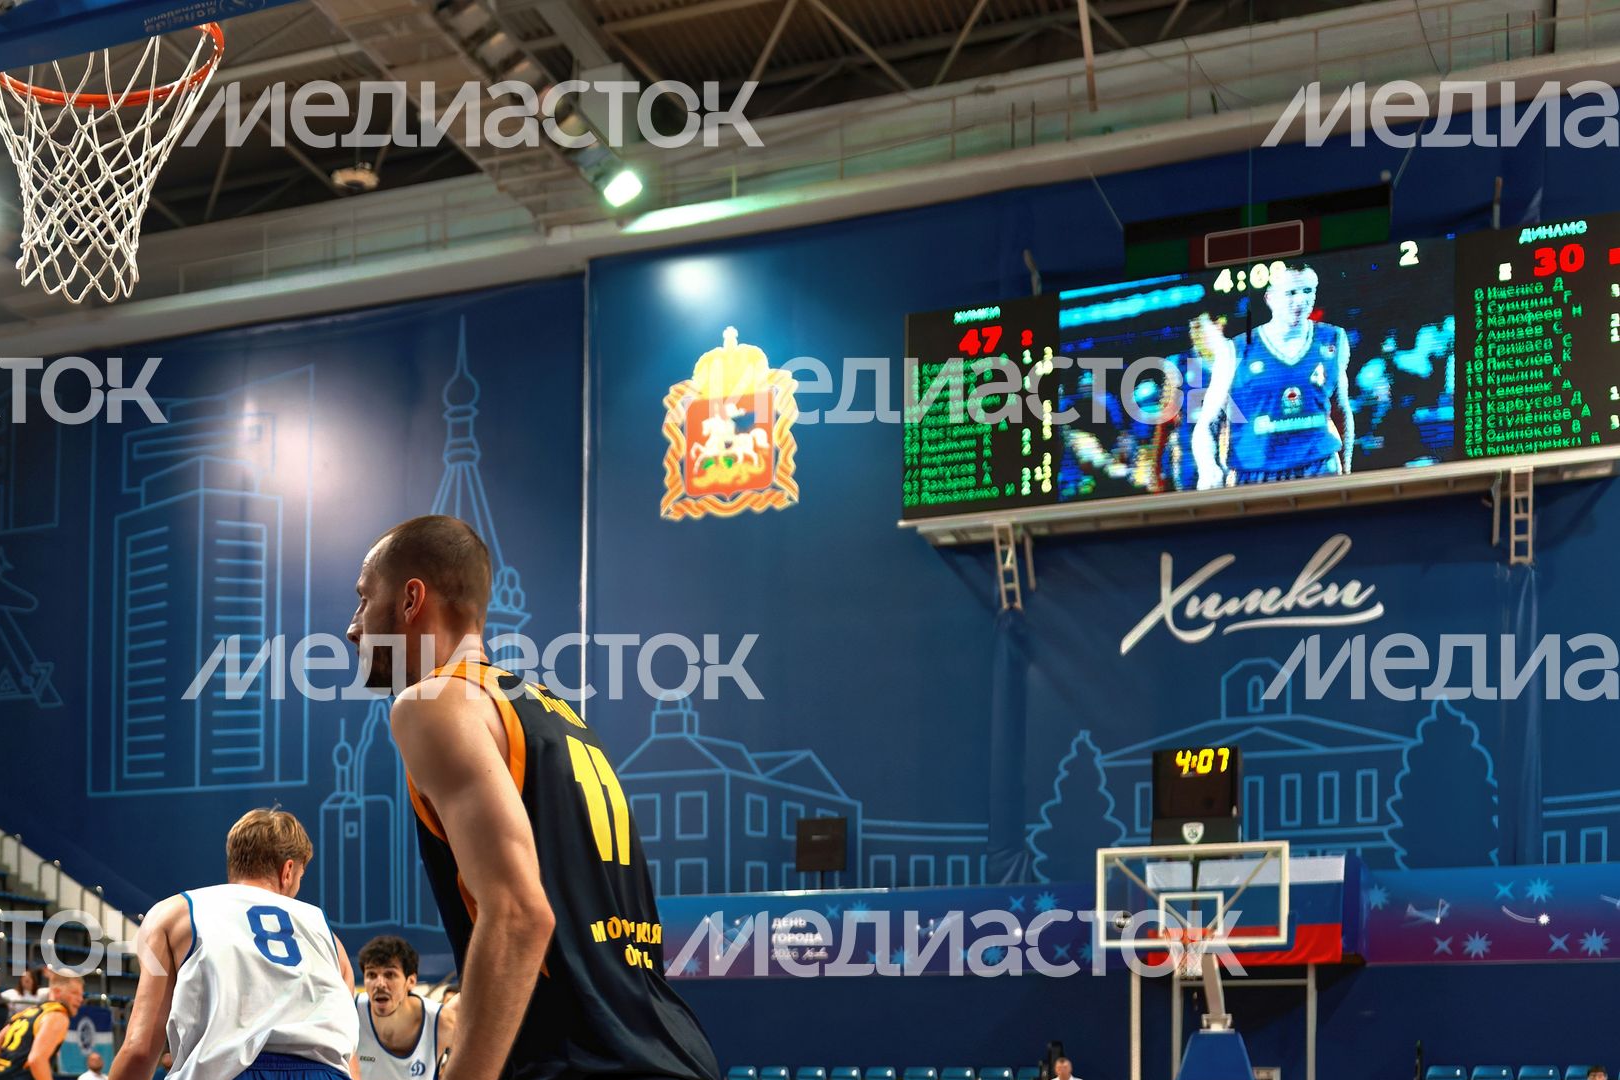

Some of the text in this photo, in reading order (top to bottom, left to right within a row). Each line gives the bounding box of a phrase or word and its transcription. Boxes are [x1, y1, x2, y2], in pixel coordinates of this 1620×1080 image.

[1519, 220, 1588, 245] ДИНАМО
[1399, 240, 1420, 266] 2
[1533, 243, 1585, 277] 30
[958, 326, 1003, 356] 47
[1120, 533, 1379, 656] Химки
[1175, 747, 1230, 775] 4:07
[566, 734, 630, 866] 11
[246, 905, 302, 967] 8
